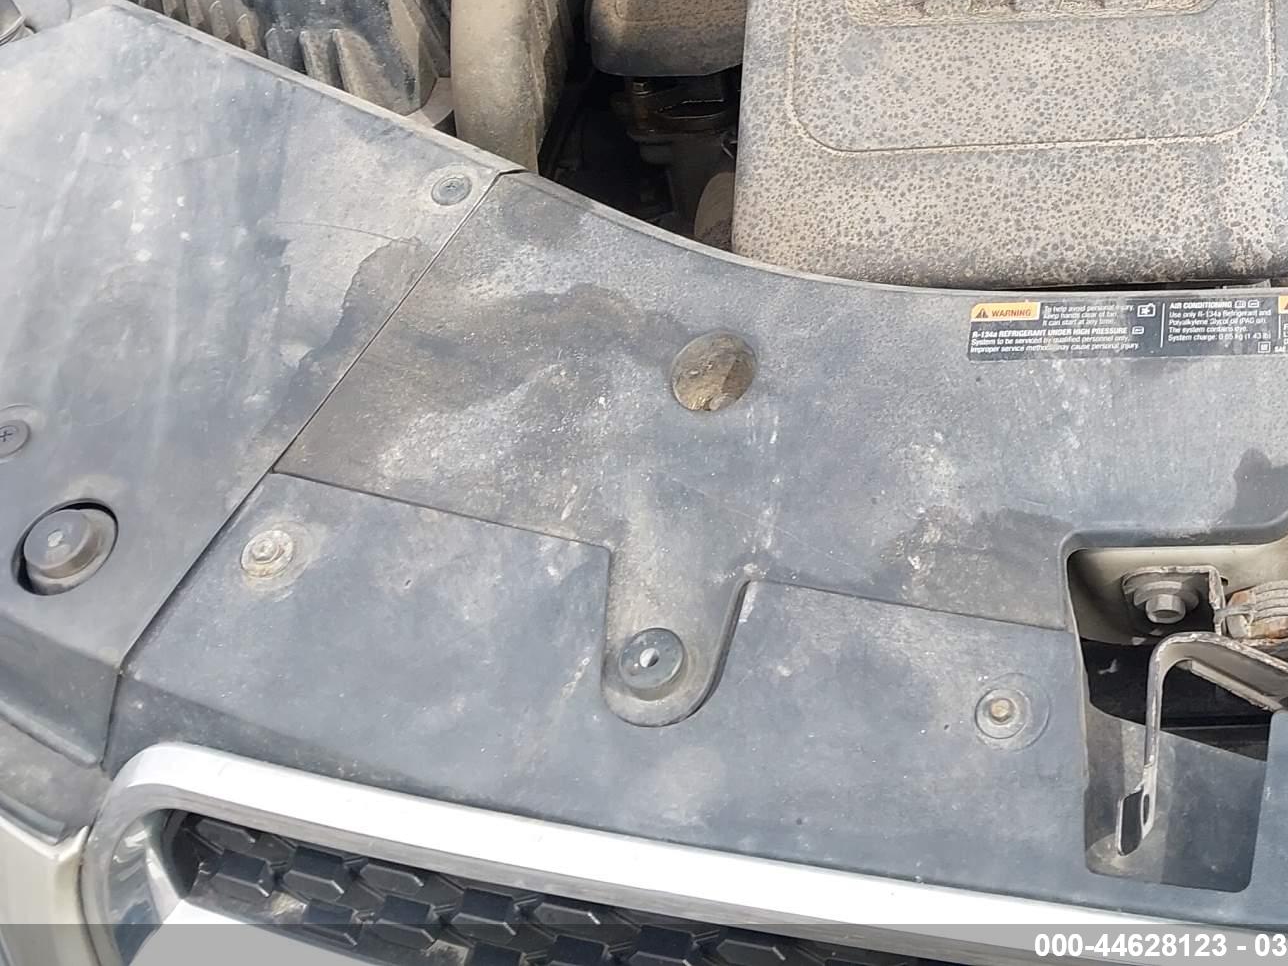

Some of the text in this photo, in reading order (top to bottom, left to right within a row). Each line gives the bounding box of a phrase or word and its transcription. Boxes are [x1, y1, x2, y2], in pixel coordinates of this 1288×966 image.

[991, 309, 1031, 317] WARNING
[1182, 311, 1196, 319] only
[998, 330, 1047, 338] REFRIGERANT
